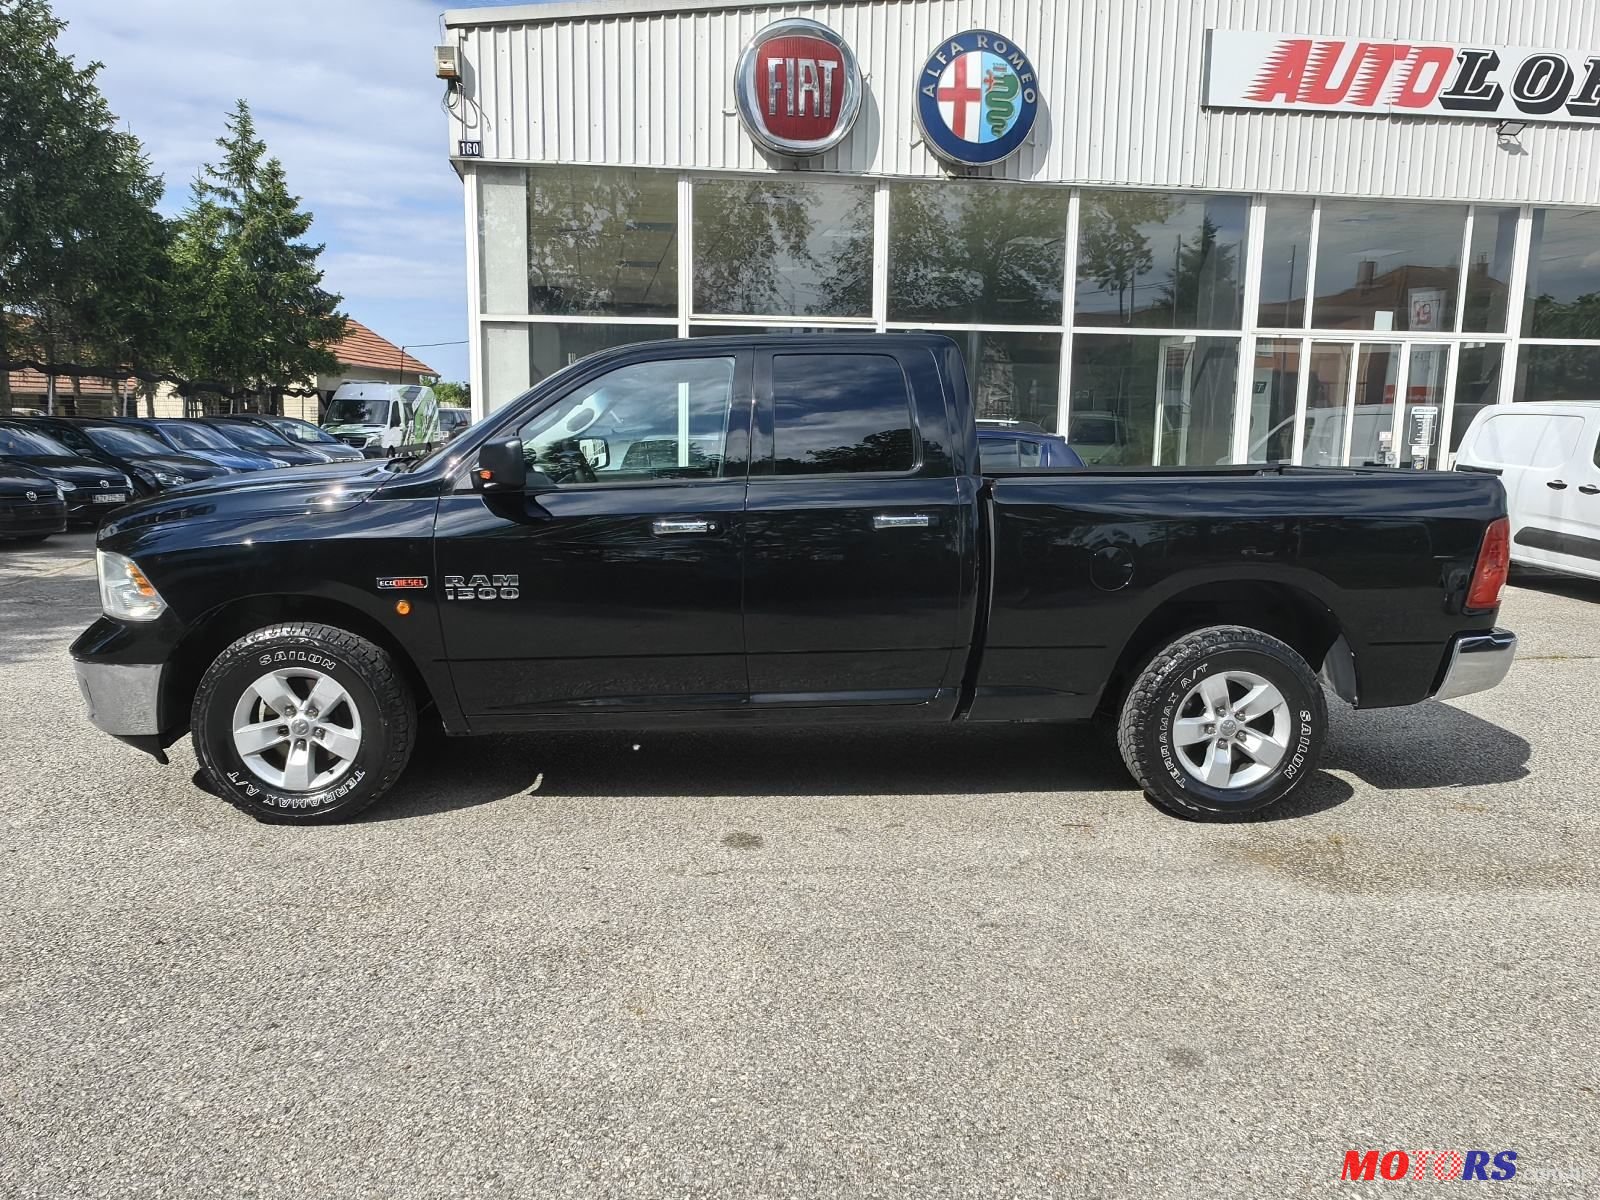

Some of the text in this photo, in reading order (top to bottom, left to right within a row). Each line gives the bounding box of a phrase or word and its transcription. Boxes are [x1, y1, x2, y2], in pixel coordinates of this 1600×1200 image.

[767, 57, 838, 118] FIAT
[923, 34, 1037, 104] ALFA ROMEO
[461, 142, 479, 155] 160
[444, 574, 519, 587] RAM
[444, 588, 520, 600] 1500
[259, 651, 336, 670] SAILUN
[1159, 663, 1208, 788] TERRAMAX A/T
[1283, 710, 1312, 779] SAILUN
[227, 770, 366, 808] TERRAMAX A/T
